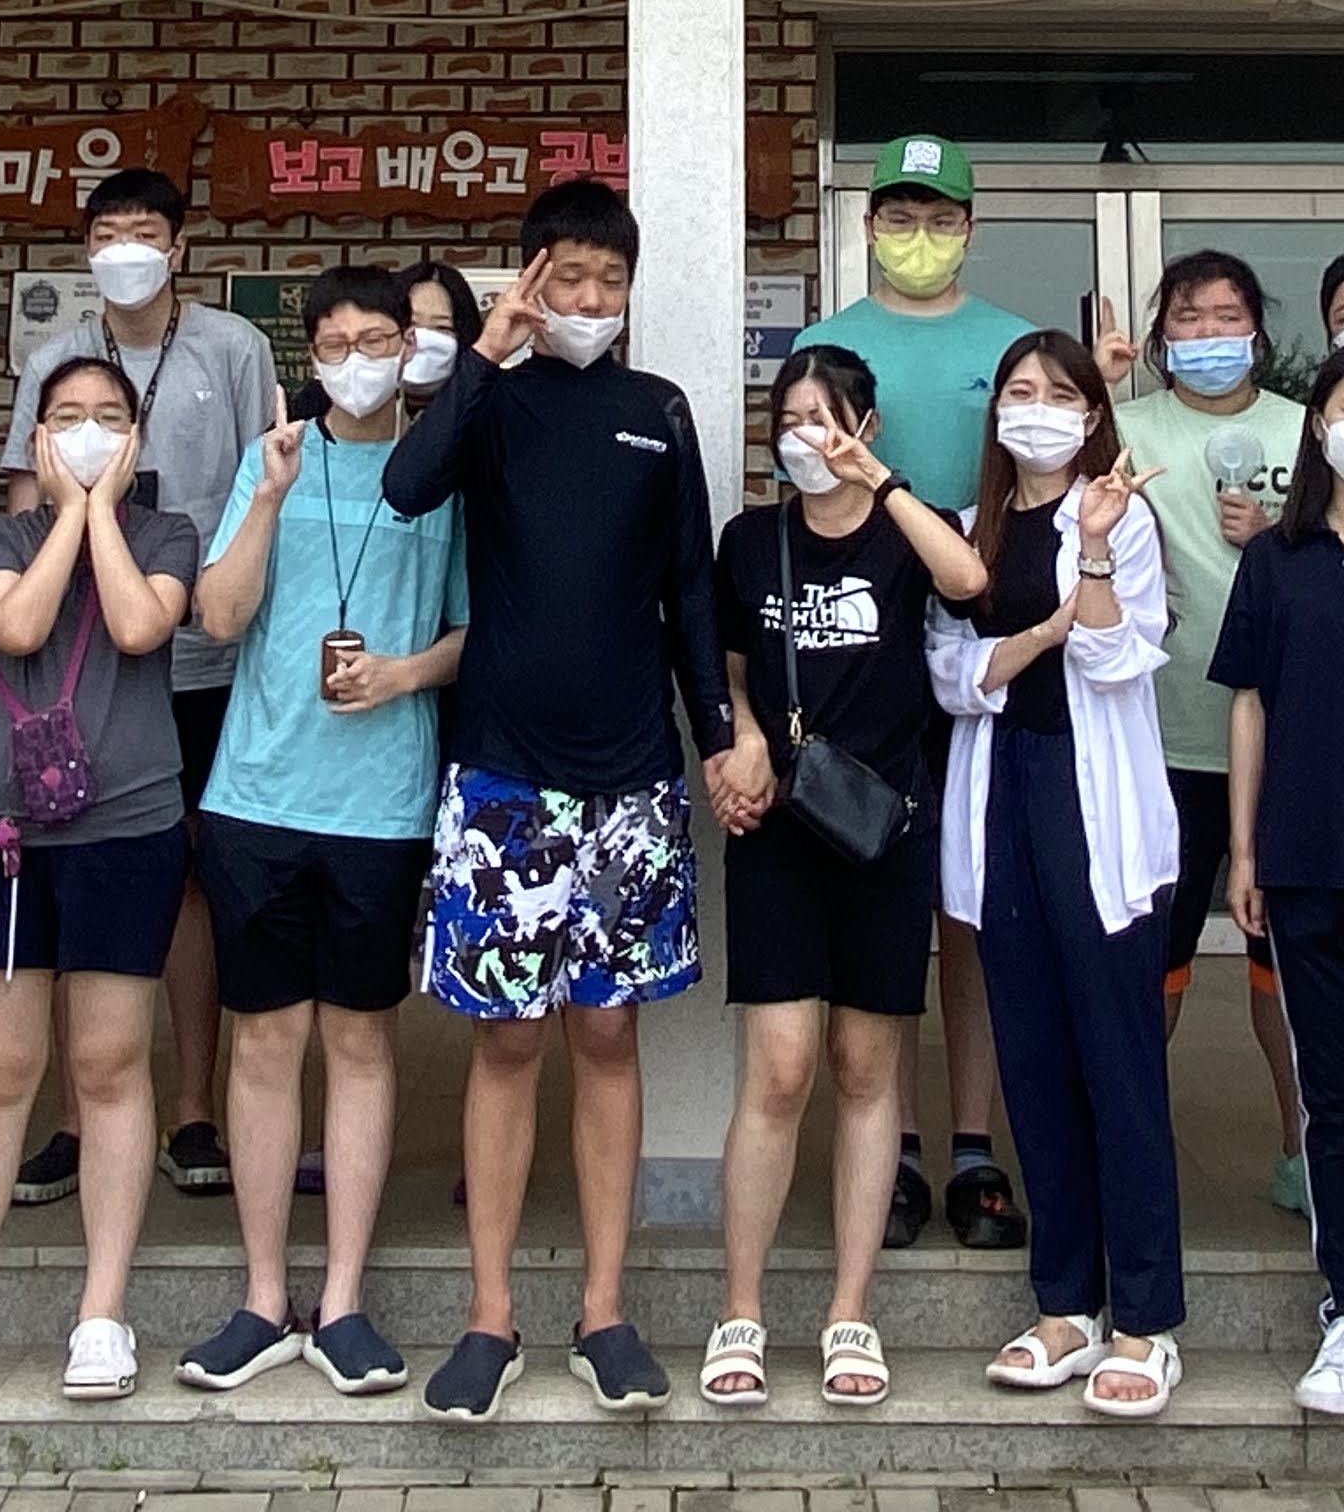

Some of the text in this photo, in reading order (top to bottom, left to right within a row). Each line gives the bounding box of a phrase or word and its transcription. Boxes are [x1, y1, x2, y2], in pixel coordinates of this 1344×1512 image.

[268, 139, 364, 194] 보고
[376, 130, 529, 197] 배우고
[717, 1325, 761, 1348] NIKE
[830, 1328, 873, 1350] NIKE
